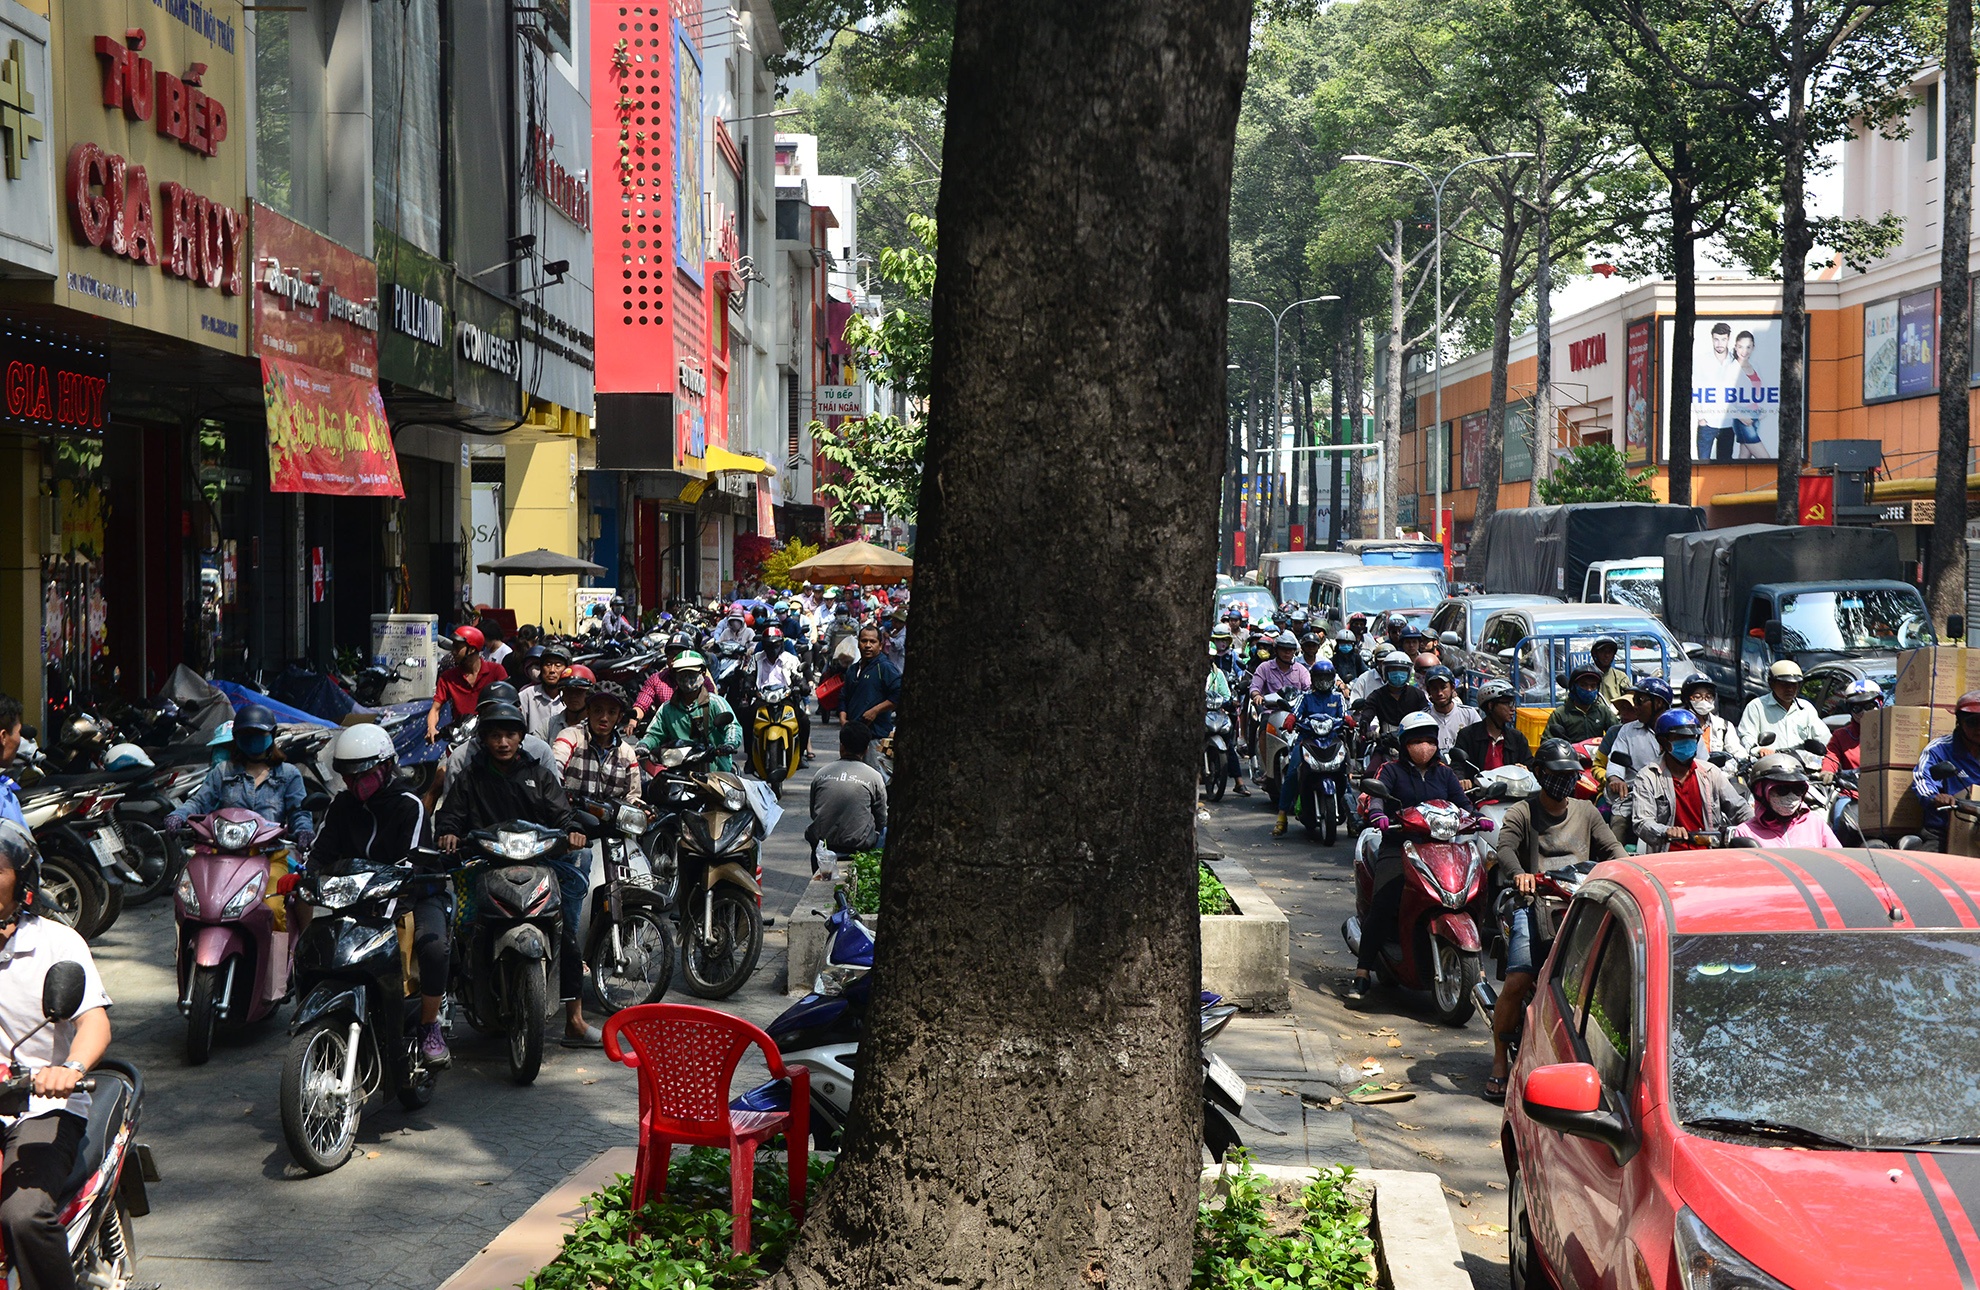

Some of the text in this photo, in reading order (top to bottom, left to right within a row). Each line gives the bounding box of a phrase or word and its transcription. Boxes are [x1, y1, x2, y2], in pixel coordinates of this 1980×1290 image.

[94, 28, 228, 157] TỦ BẾP
[66, 142, 248, 296] GIA HUY
[394, 283, 443, 348] PALLADIUM
[462, 321, 512, 375] CONVERSE
[1568, 332, 1607, 372] VINCOM
[6, 360, 106, 428] GIA HUY
[818, 401, 860, 411] THÁI NGÂN
[824, 388, 853, 399] TỦ BẾP
[1724, 387, 1779, 404] BLUE
